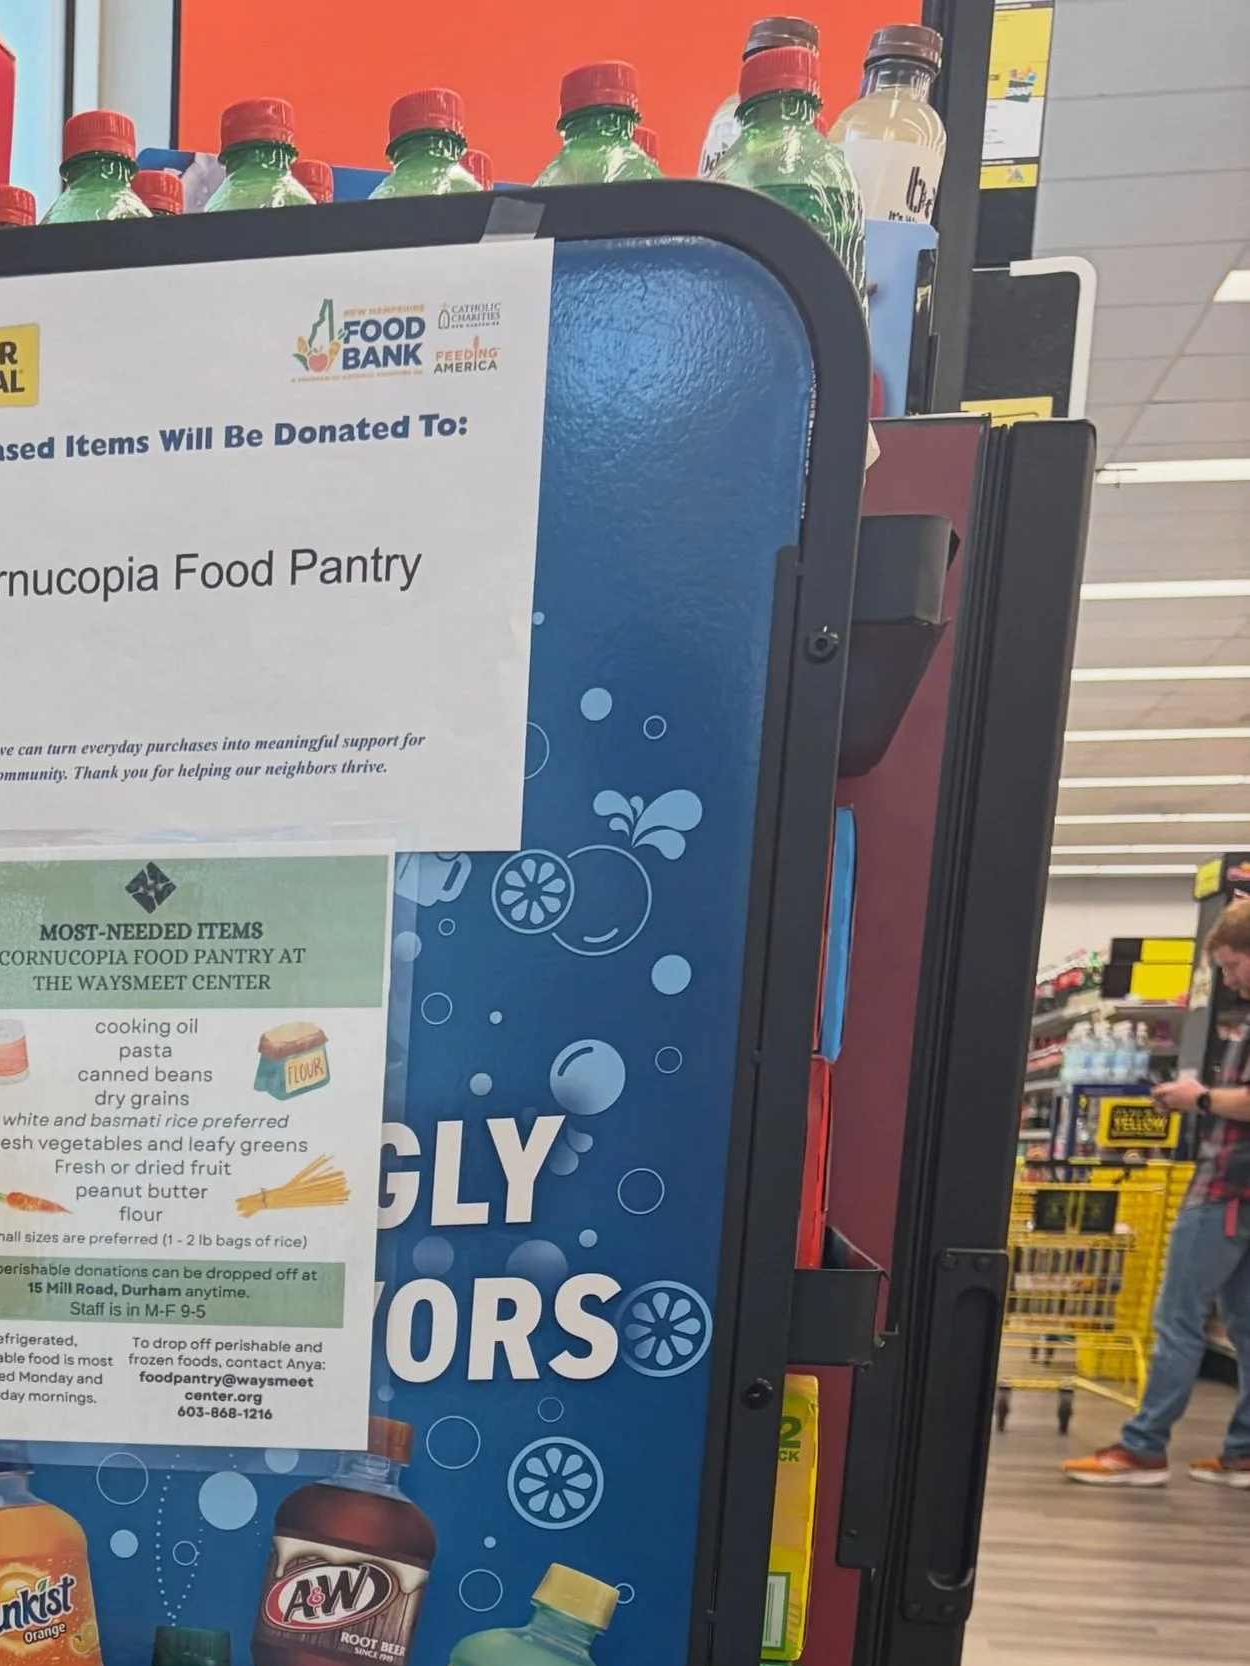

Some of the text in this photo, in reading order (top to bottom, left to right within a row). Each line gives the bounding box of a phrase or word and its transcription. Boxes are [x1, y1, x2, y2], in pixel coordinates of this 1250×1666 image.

[451, 302, 500, 314] CATHOLIC
[451, 312, 500, 323] CHARITIES
[343, 316, 426, 344] FOOD
[342, 342, 423, 370] BANK
[435, 341, 498, 362] FEEDING
[434, 360, 498, 374] AMERICA
[65, 434, 149, 458] Items
[159, 427, 213, 452] Will
[224, 424, 263, 448] Be
[274, 415, 410, 446] Donated
[419, 413, 468, 437] To:
[174, 550, 274, 590] Food
[290, 545, 423, 591] Pantry
[17, 744, 43, 756] can
[46, 742, 76, 755] turn
[81, 739, 143, 758] everyday
[145, 736, 218, 757] purchases
[222, 736, 250, 751] into
[255, 734, 340, 753] meaningful
[342, 734, 399, 751] support
[399, 732, 425, 750] for
[74, 764, 119, 780] Thank
[121, 766, 148, 782] you
[149, 764, 174, 781] for
[178, 762, 232, 781] helping
[236, 766, 261, 777] our
[265, 760, 337, 779] neighbors
[341, 759, 388, 774] thrive.
[39, 921, 263, 942] MOST-NEEDED ITEMS
[134, 948, 188, 965] FOOD
[194, 947, 275, 965] PANTRY
[277, 947, 306, 964] AT
[33, 974, 271, 991] THE WAYSMEET CENTER
[95, 1017, 198, 1037] cooking oil
[119, 1043, 172, 1061] pasta
[78, 1066, 213, 1083] canned beans
[287, 1059, 323, 1086] FLOUR
[95, 1091, 189, 1110] dry grains
[38, 1136, 143, 1155] vegetables
[148, 1136, 182, 1152] and
[188, 1136, 235, 1156] leafy
[240, 1139, 308, 1156] greens
[55, 1160, 232, 1176] Fresh or dried fruit
[76, 1184, 208, 1204] peanut butter
[119, 1206, 163, 1222] flour
[28, 1282, 250, 1300] 15 Mill Road, Durham anytime.
[69, 1301, 206, 1319] Staff is in M-F 9-5
[139, 1371, 314, 1389] foodpantry@waysmeet
[184, 1391, 262, 1406] center.org
[177, 1406, 273, 1421] 603-868-1216
[282, 1564, 371, 1626] A&W
[24, 1622, 66, 1644] Orange
[340, 1632, 405, 1658] ROOT BEER
